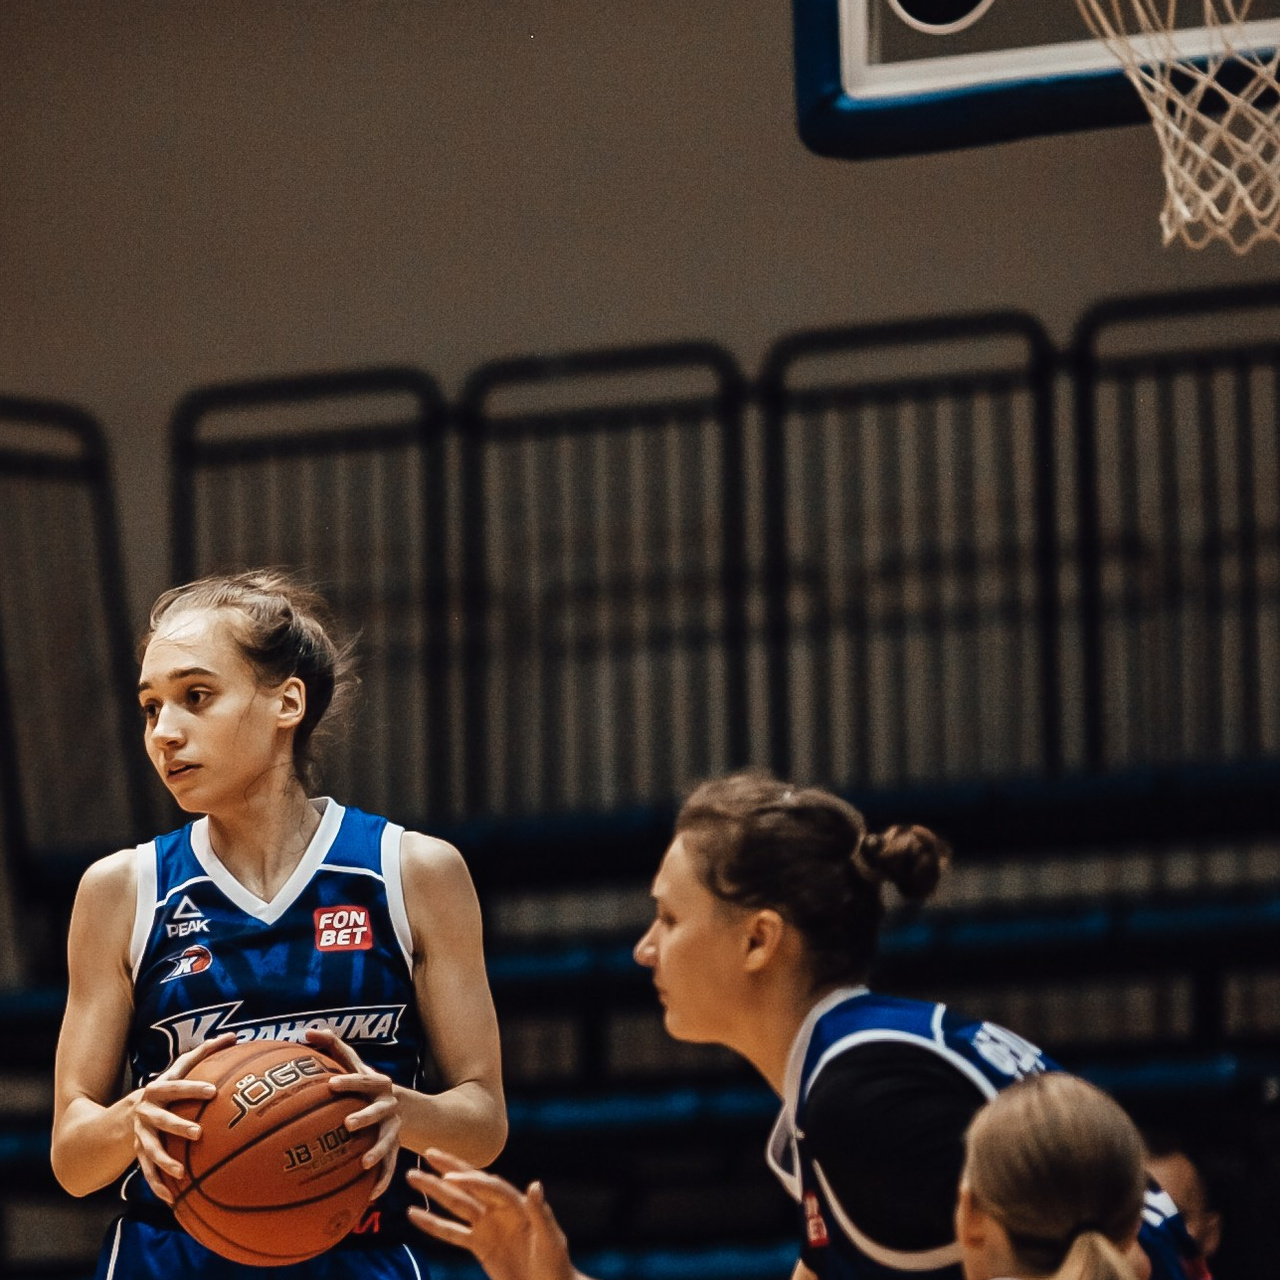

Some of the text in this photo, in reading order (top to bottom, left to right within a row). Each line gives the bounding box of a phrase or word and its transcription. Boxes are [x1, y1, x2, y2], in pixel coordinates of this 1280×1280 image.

[166, 919, 211, 937] PEAK
[319, 911, 365, 929] FON
[320, 927, 367, 946] BET
[172, 1012, 395, 1054] КЗАНОЧКА
